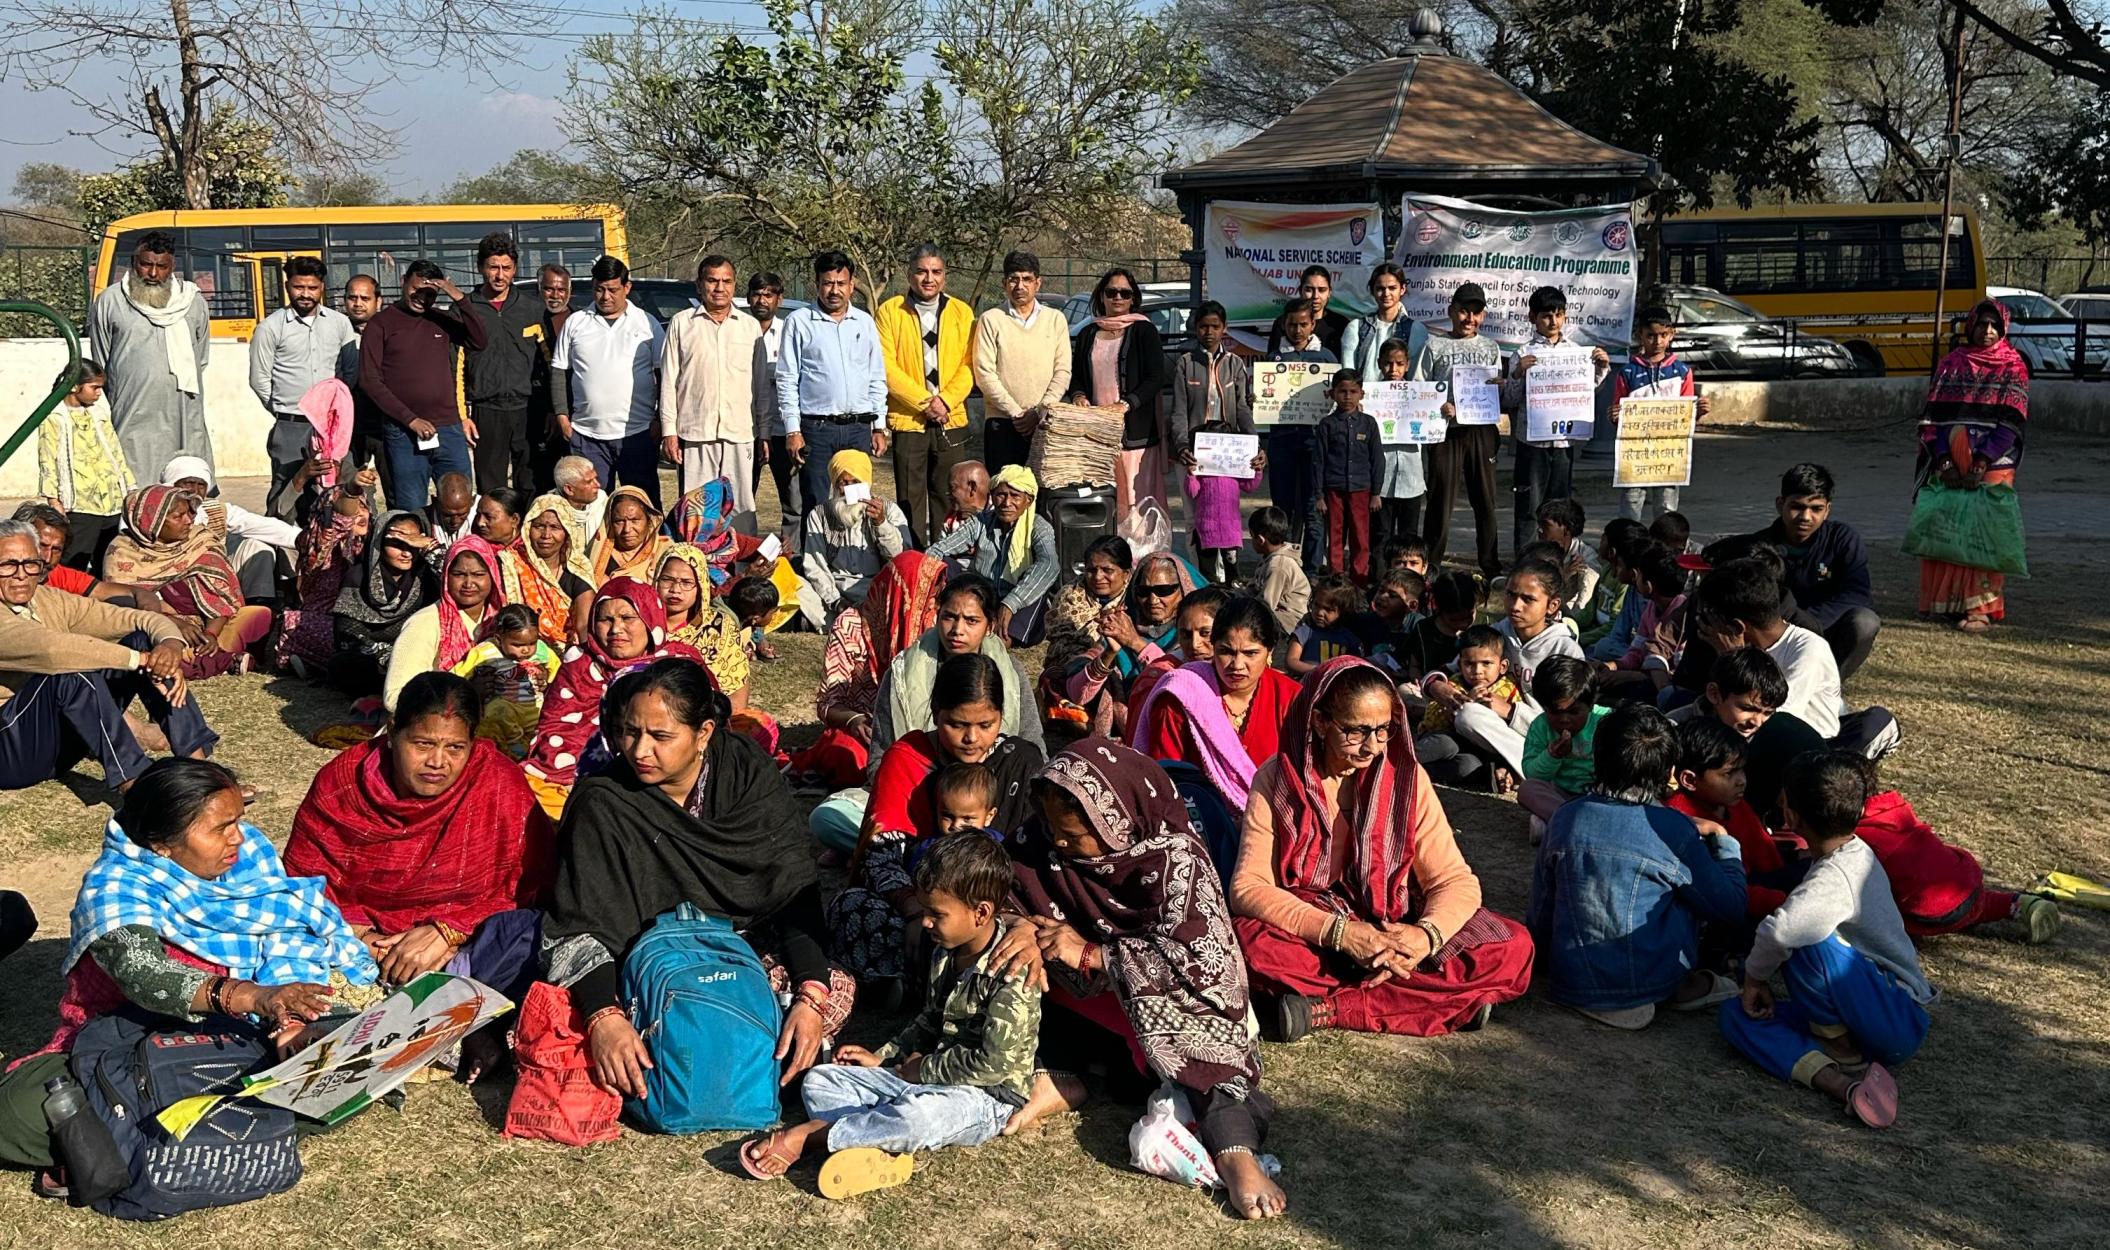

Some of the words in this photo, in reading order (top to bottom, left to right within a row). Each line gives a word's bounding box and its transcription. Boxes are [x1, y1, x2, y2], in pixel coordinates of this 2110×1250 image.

[1278, 248, 1324, 263] SERVICE
[1326, 250, 1362, 265] SCHEME
[1402, 251, 1483, 269] Environment
[1484, 252, 1550, 273] Education
[1552, 255, 1630, 275] Programme
[1406, 279, 1436, 291] Punjab
[1501, 281, 1514, 292] for
[1567, 285, 1620, 300] Technology
[1509, 297, 1519, 307] of
[1586, 315, 1623, 329] Change
[1288, 363, 1307, 372] NSS
[1389, 382, 1409, 391] NSS
[698, 971, 737, 983] safari
[351, 1010, 386, 1045] SIDHU
[1164, 1129, 1198, 1165] Thank
